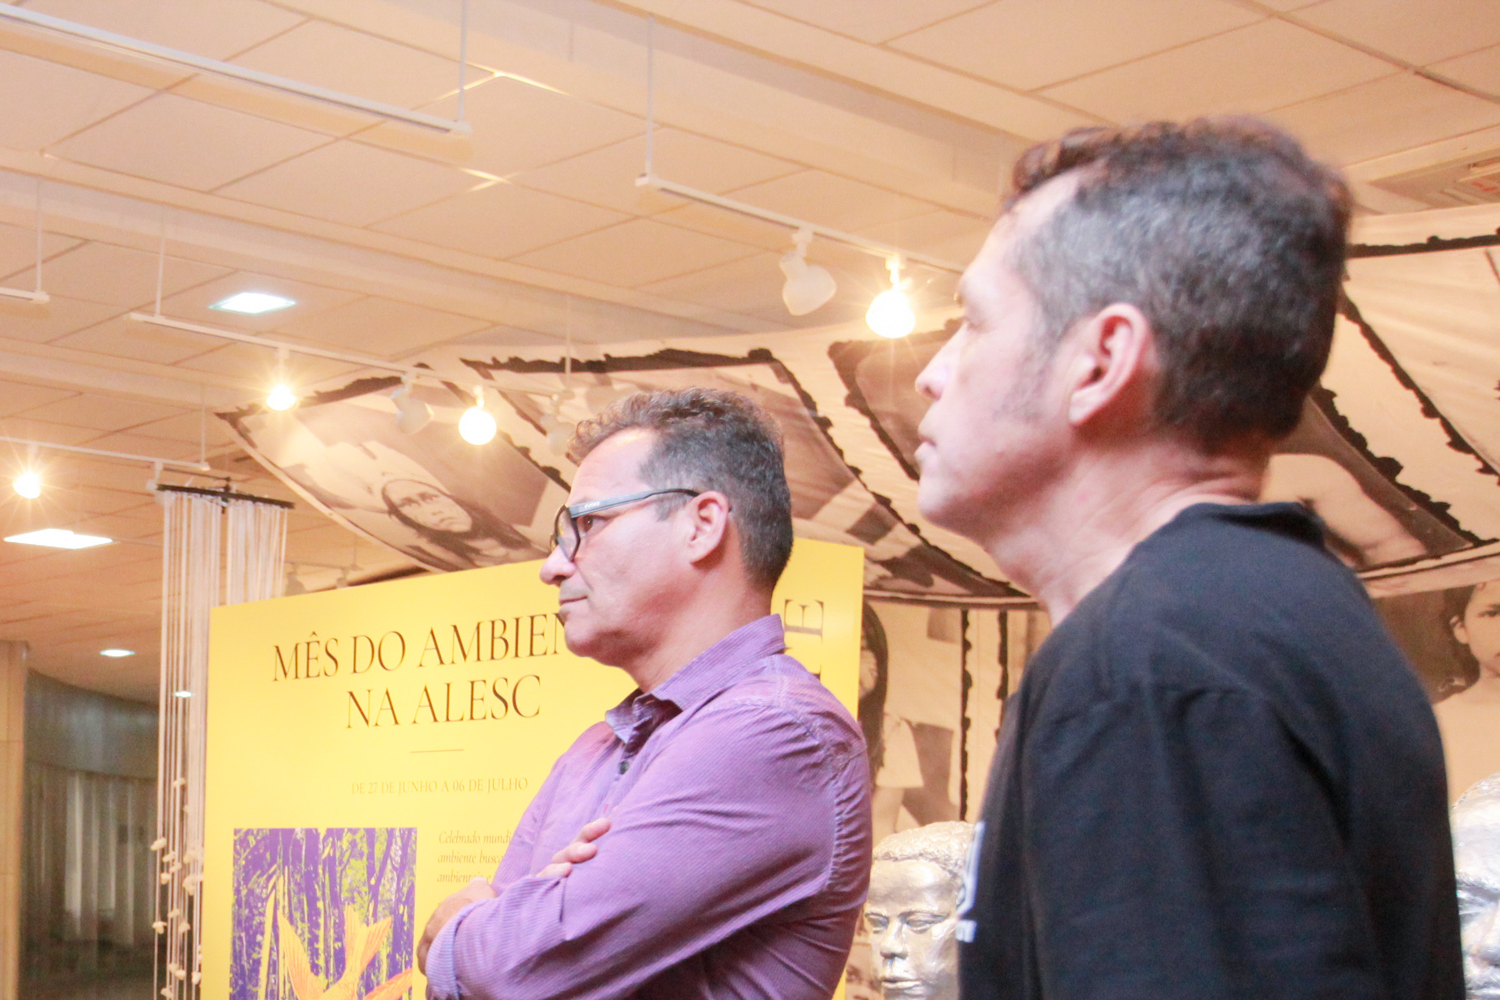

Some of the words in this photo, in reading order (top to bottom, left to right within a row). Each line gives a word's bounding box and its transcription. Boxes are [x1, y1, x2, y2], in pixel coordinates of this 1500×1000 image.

[272, 631, 339, 682] MÊS
[350, 630, 406, 674] DO
[346, 686, 400, 728] NA
[412, 674, 541, 724] ALESC
[351, 782, 365, 794] DE
[367, 782, 378, 794] 27
[381, 781, 395, 794] DE
[398, 780, 438, 797] JUNHO
[440, 779, 450, 792] A
[452, 778, 465, 792] 06
[468, 778, 484, 792] DE
[487, 777, 529, 793] JULHO
[438, 830, 481, 844] Celebrado
[437, 850, 476, 864] ambiente
